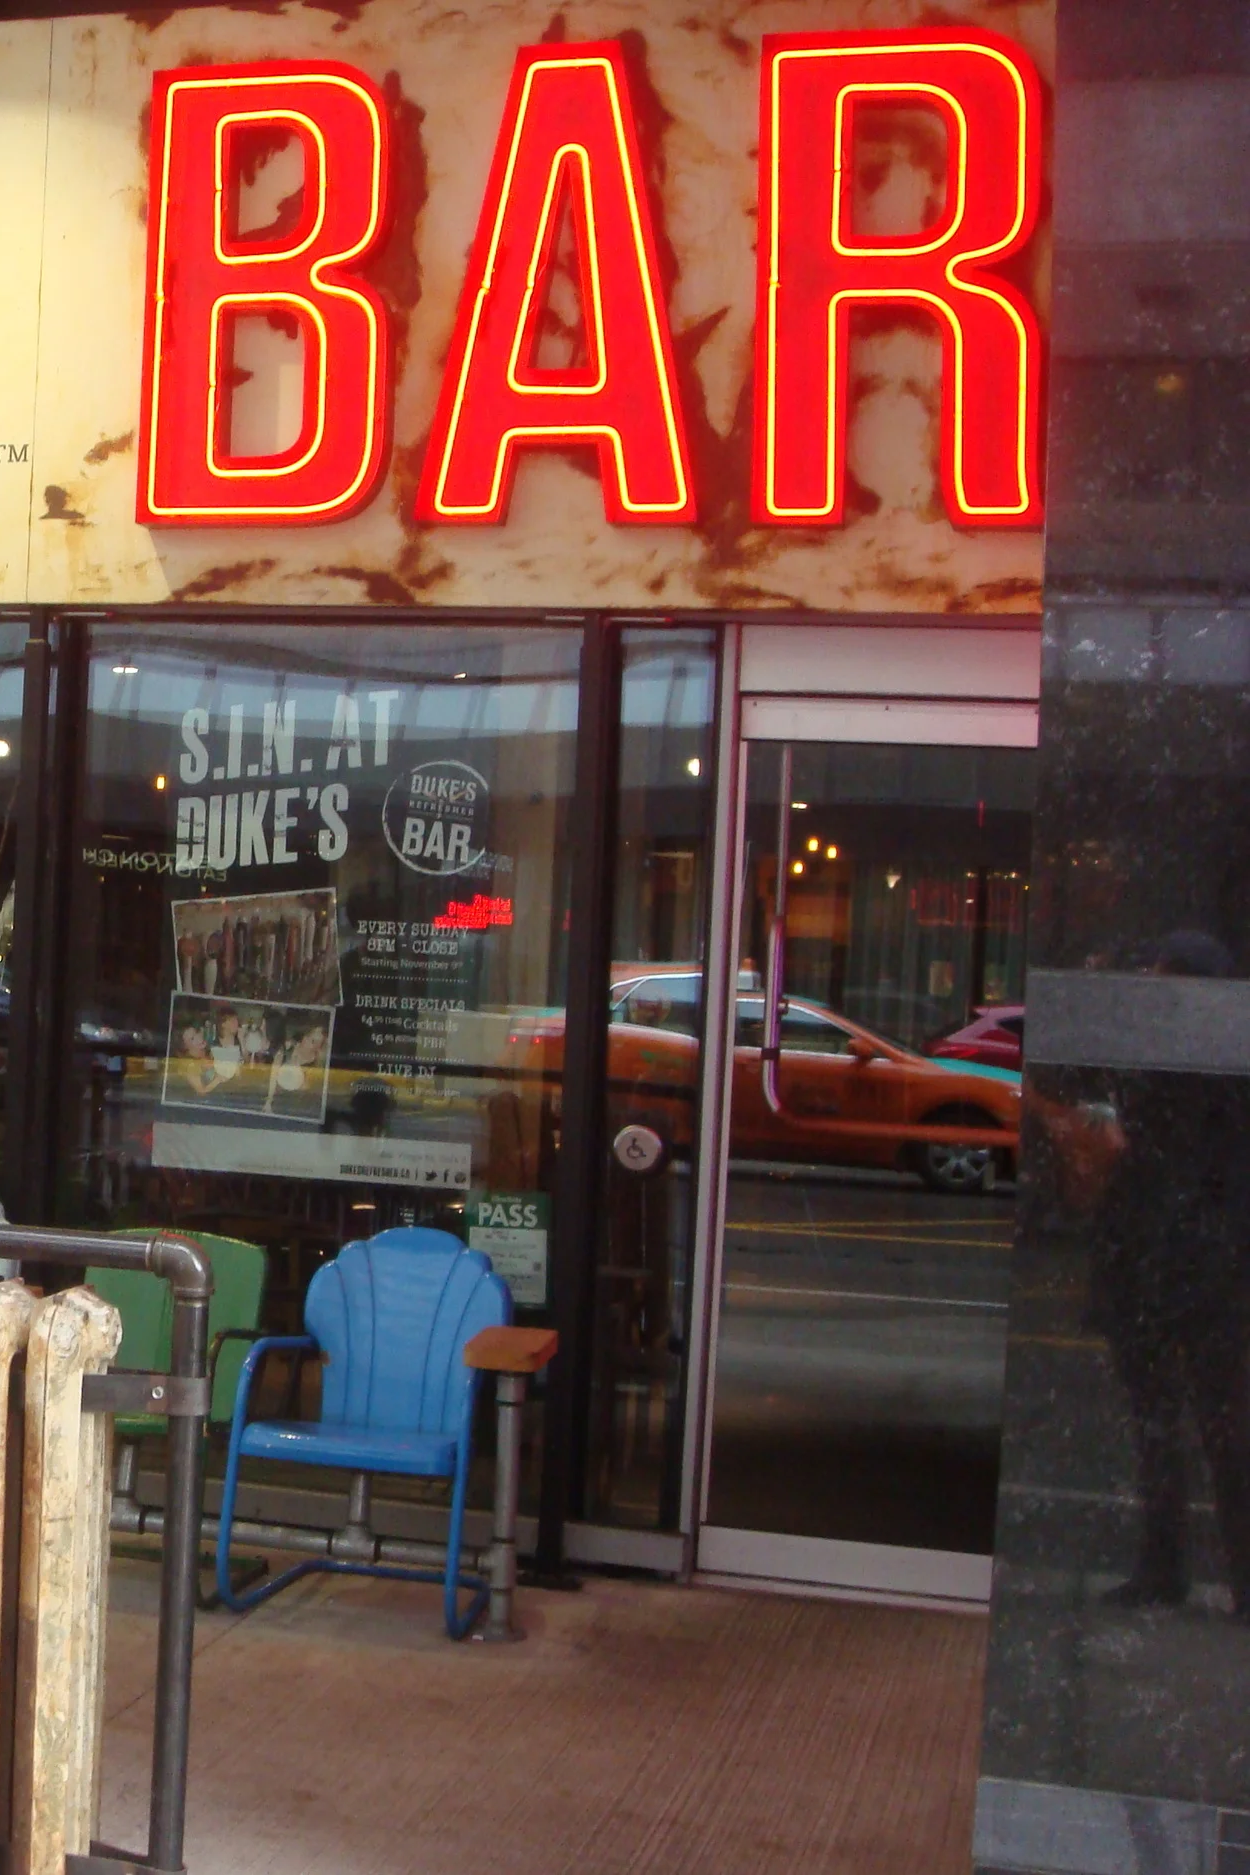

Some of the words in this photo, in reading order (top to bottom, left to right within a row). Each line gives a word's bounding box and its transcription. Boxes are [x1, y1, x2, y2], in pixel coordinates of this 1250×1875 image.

[136, 28, 1042, 527] BAR
[179, 700, 313, 785] S.I.N.
[326, 690, 401, 770] AT
[411, 775, 477, 802] DUKE'S
[176, 783, 349, 872] DUKE'S
[402, 817, 471, 864] BAR
[357, 920, 406, 937] EVERY
[411, 922, 469, 939] SUNDAY
[367, 938, 396, 953] 8PM
[412, 940, 458, 956] CLOSE
[361, 957, 398, 970] Starting
[400, 958, 448, 971] November
[355, 994, 398, 1009] DRINK
[401, 997, 465, 1012] SPECIALS
[403, 1018, 459, 1033] Cocktails
[375, 1063, 412, 1079] LIVE
[418, 1065, 437, 1079] DJ
[478, 1202, 538, 1228] PASS
